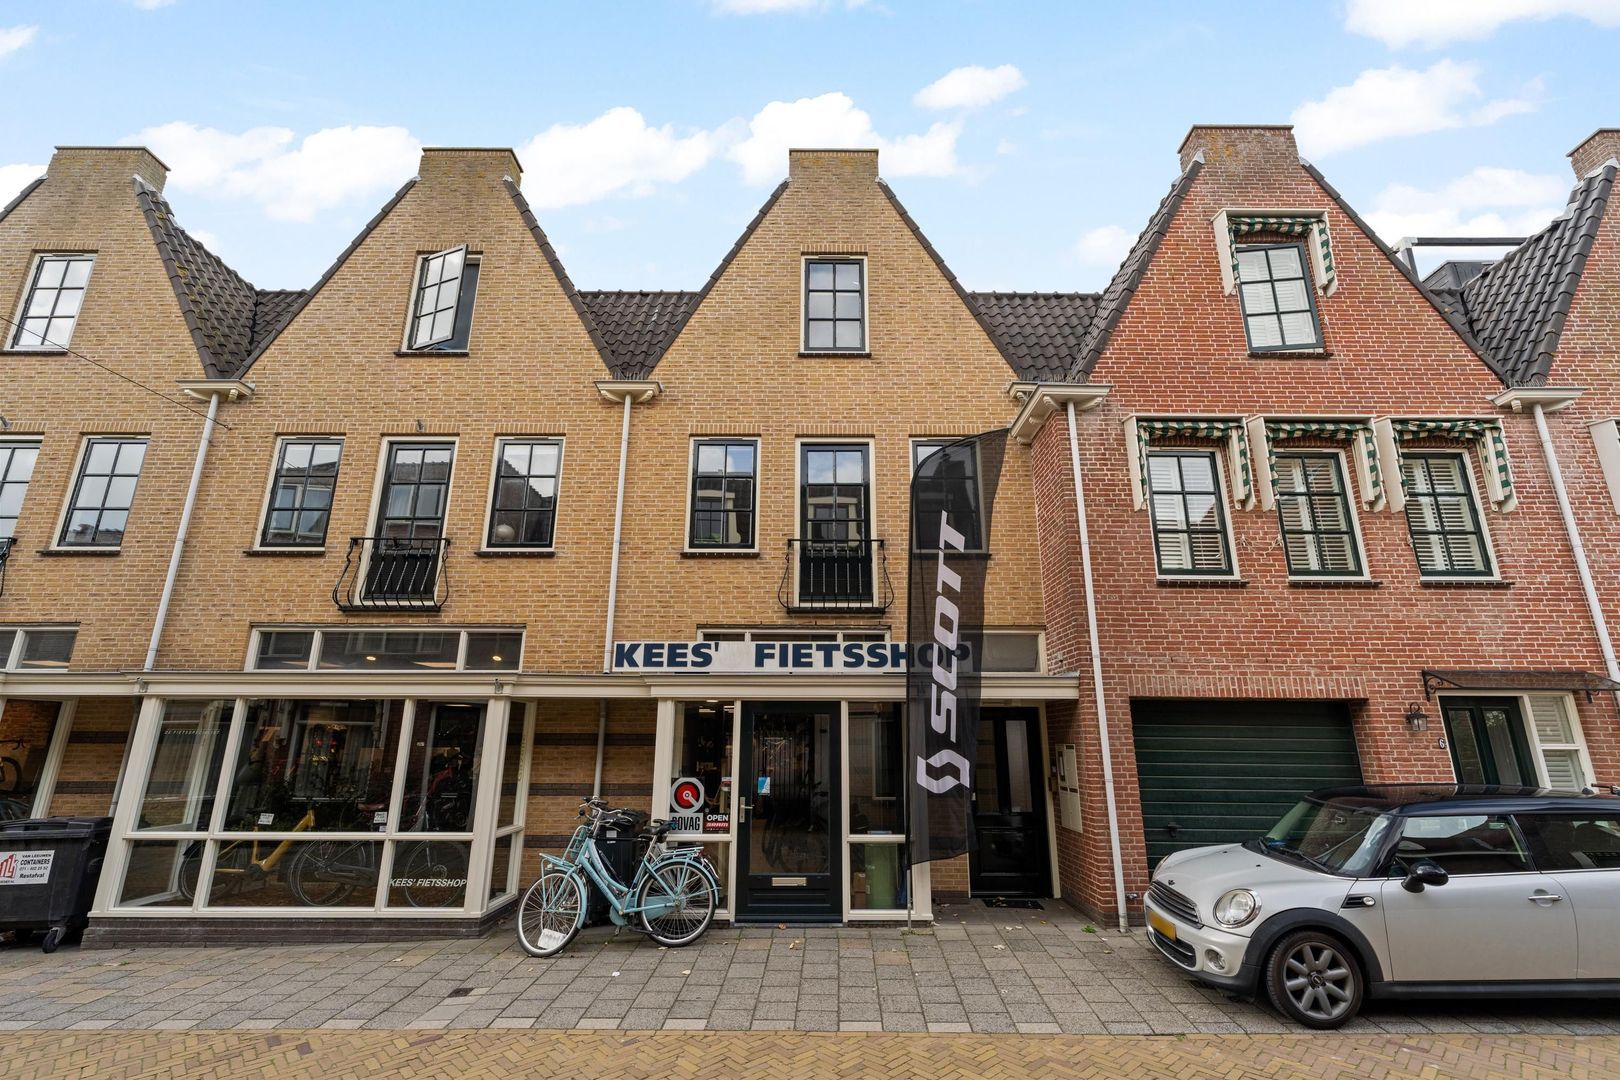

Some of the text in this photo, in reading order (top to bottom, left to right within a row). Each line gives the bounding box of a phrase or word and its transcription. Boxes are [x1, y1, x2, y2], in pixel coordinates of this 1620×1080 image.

[930, 509, 965, 744] SCOTT
[614, 641, 971, 669] KEES' FIETSSHOP
[706, 814, 729, 822] OPEN
[416, 878, 467, 887] FIETSSHOP
